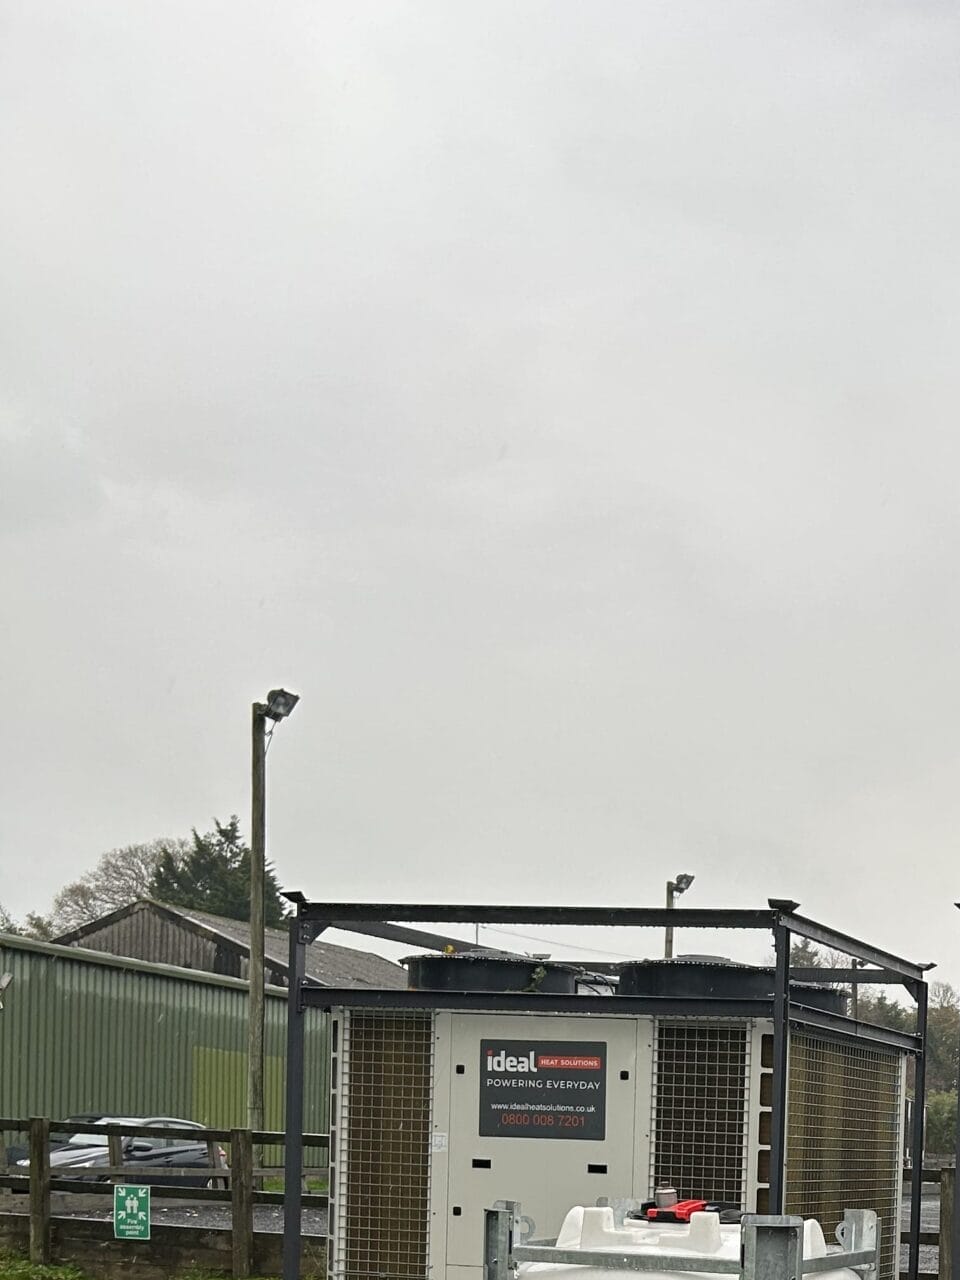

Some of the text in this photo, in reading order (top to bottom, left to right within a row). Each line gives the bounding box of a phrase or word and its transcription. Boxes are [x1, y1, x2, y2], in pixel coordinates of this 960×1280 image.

[487, 1050, 537, 1072] ideal
[560, 1059, 598, 1067] SOLUTIONS
[487, 1079, 601, 1090] POWERING EVERYDAY
[491, 1103, 596, 1113] www.idealheatsolutions.co.uk
[501, 1113, 585, 1127] 0800 008 7201
